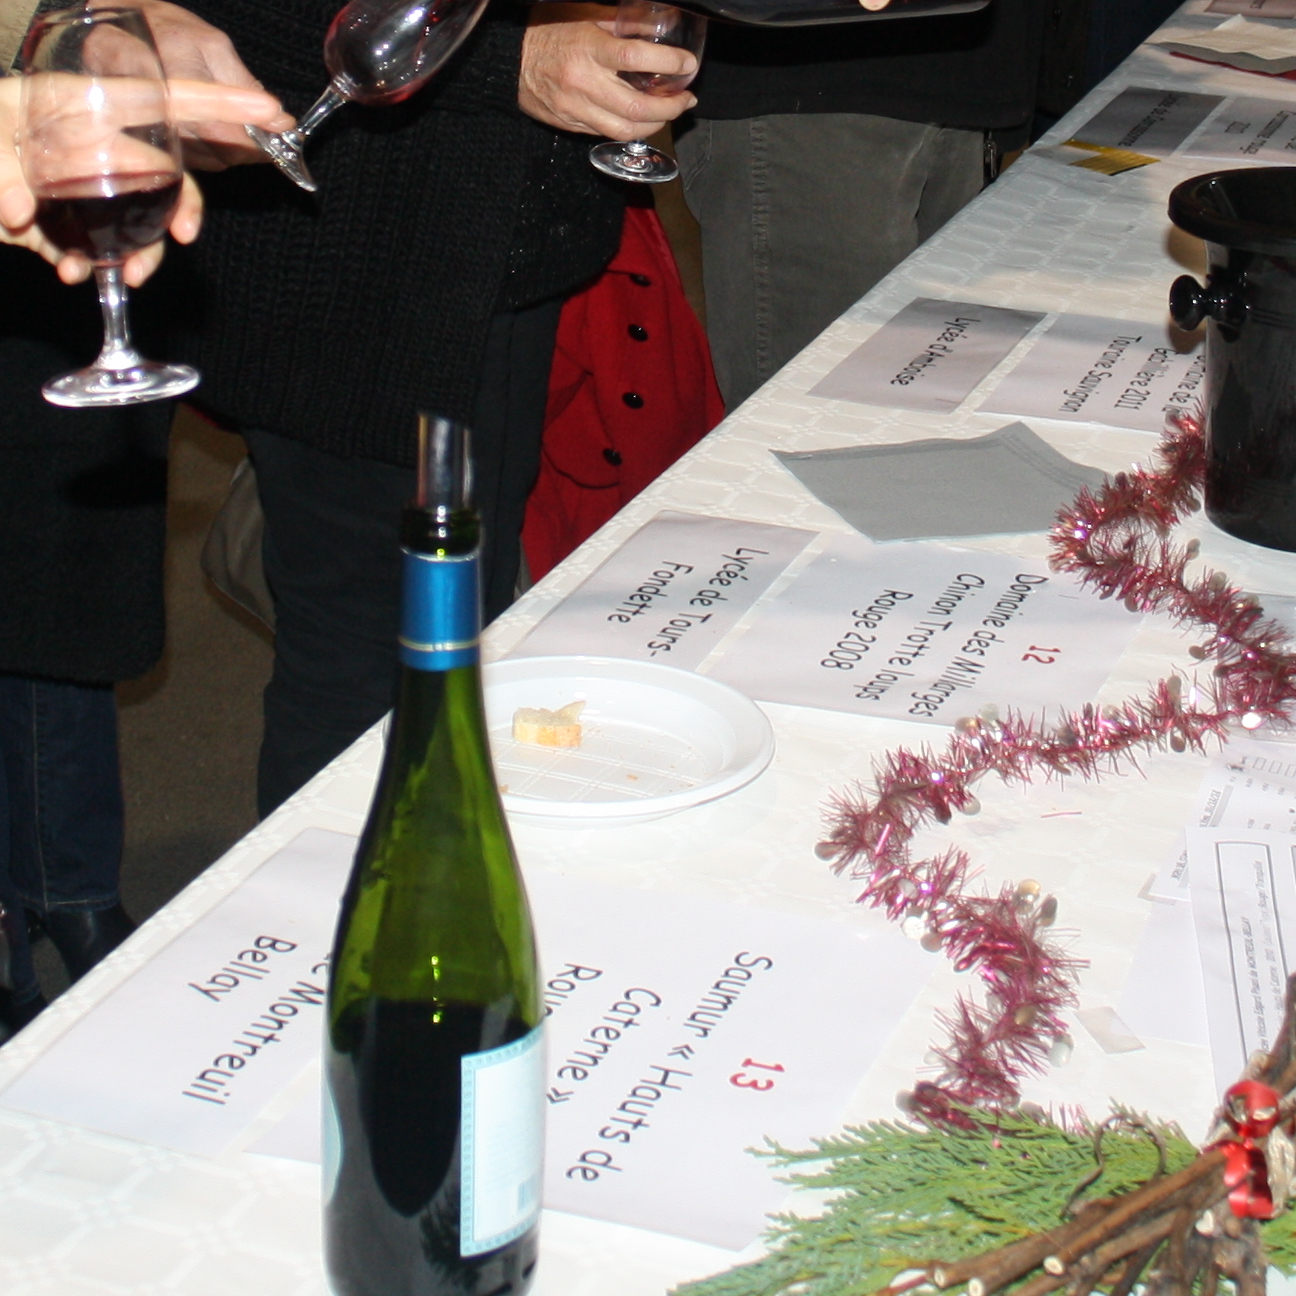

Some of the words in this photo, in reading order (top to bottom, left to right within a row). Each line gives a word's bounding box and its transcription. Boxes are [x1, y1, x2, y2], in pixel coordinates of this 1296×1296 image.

[936, 317, 981, 342] Lycée
[1094, 335, 1143, 369] Touraine
[1058, 370, 1113, 412] Sauvignon
[1114, 388, 1151, 410] 2011
[709, 547, 769, 586] Lycée
[607, 561, 694, 623] Fondette
[690, 589, 728, 606] de
[852, 589, 914, 630] Rouge
[927, 573, 985, 616] Chinon
[982, 574, 1049, 627] Domaine
[647, 613, 713, 657] Tours-
[820, 632, 876, 671] 2008
[888, 621, 952, 666] Trotte
[961, 630, 1005, 656] des
[1021, 645, 1061, 664] 12
[853, 669, 914, 701] loups
[908, 656, 985, 718] Millarges
[188, 935, 298, 1002] Bellay
[544, 963, 603, 1016] Rou
[683, 951, 773, 1038] Saumur
[182, 981, 325, 1105] Montreuil
[557, 988, 662, 1081] Caterne
[729, 1057, 785, 1091] 13
[598, 1065, 693, 1143] Hauts
[565, 1149, 622, 1181] de
